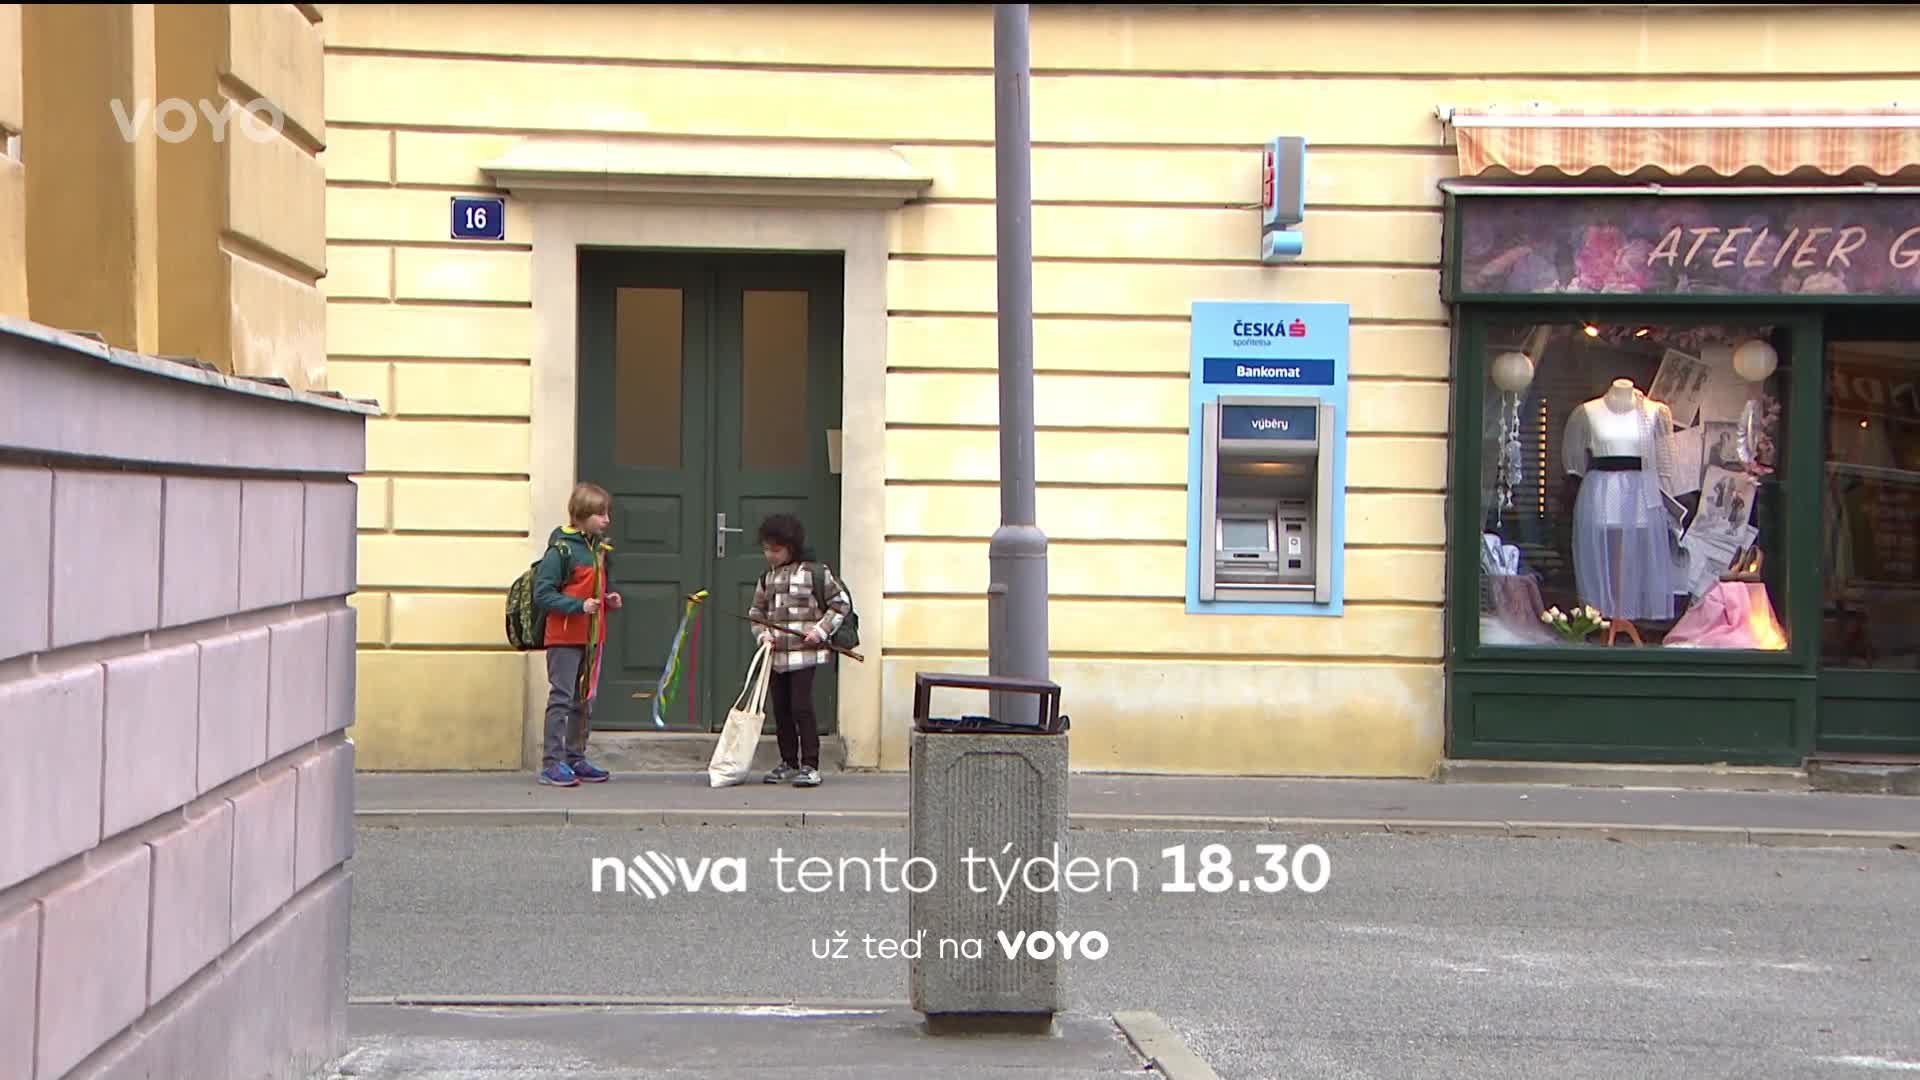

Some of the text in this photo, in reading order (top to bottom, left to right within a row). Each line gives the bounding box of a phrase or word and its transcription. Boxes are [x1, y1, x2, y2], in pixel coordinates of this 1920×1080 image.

[466, 207, 487, 229] 16
[1647, 225, 1867, 269] ATELIER
[1233, 319, 1286, 337] ČESKÁ
[1236, 365, 1301, 378] Bankomat
[1252, 417, 1289, 431] výběry
